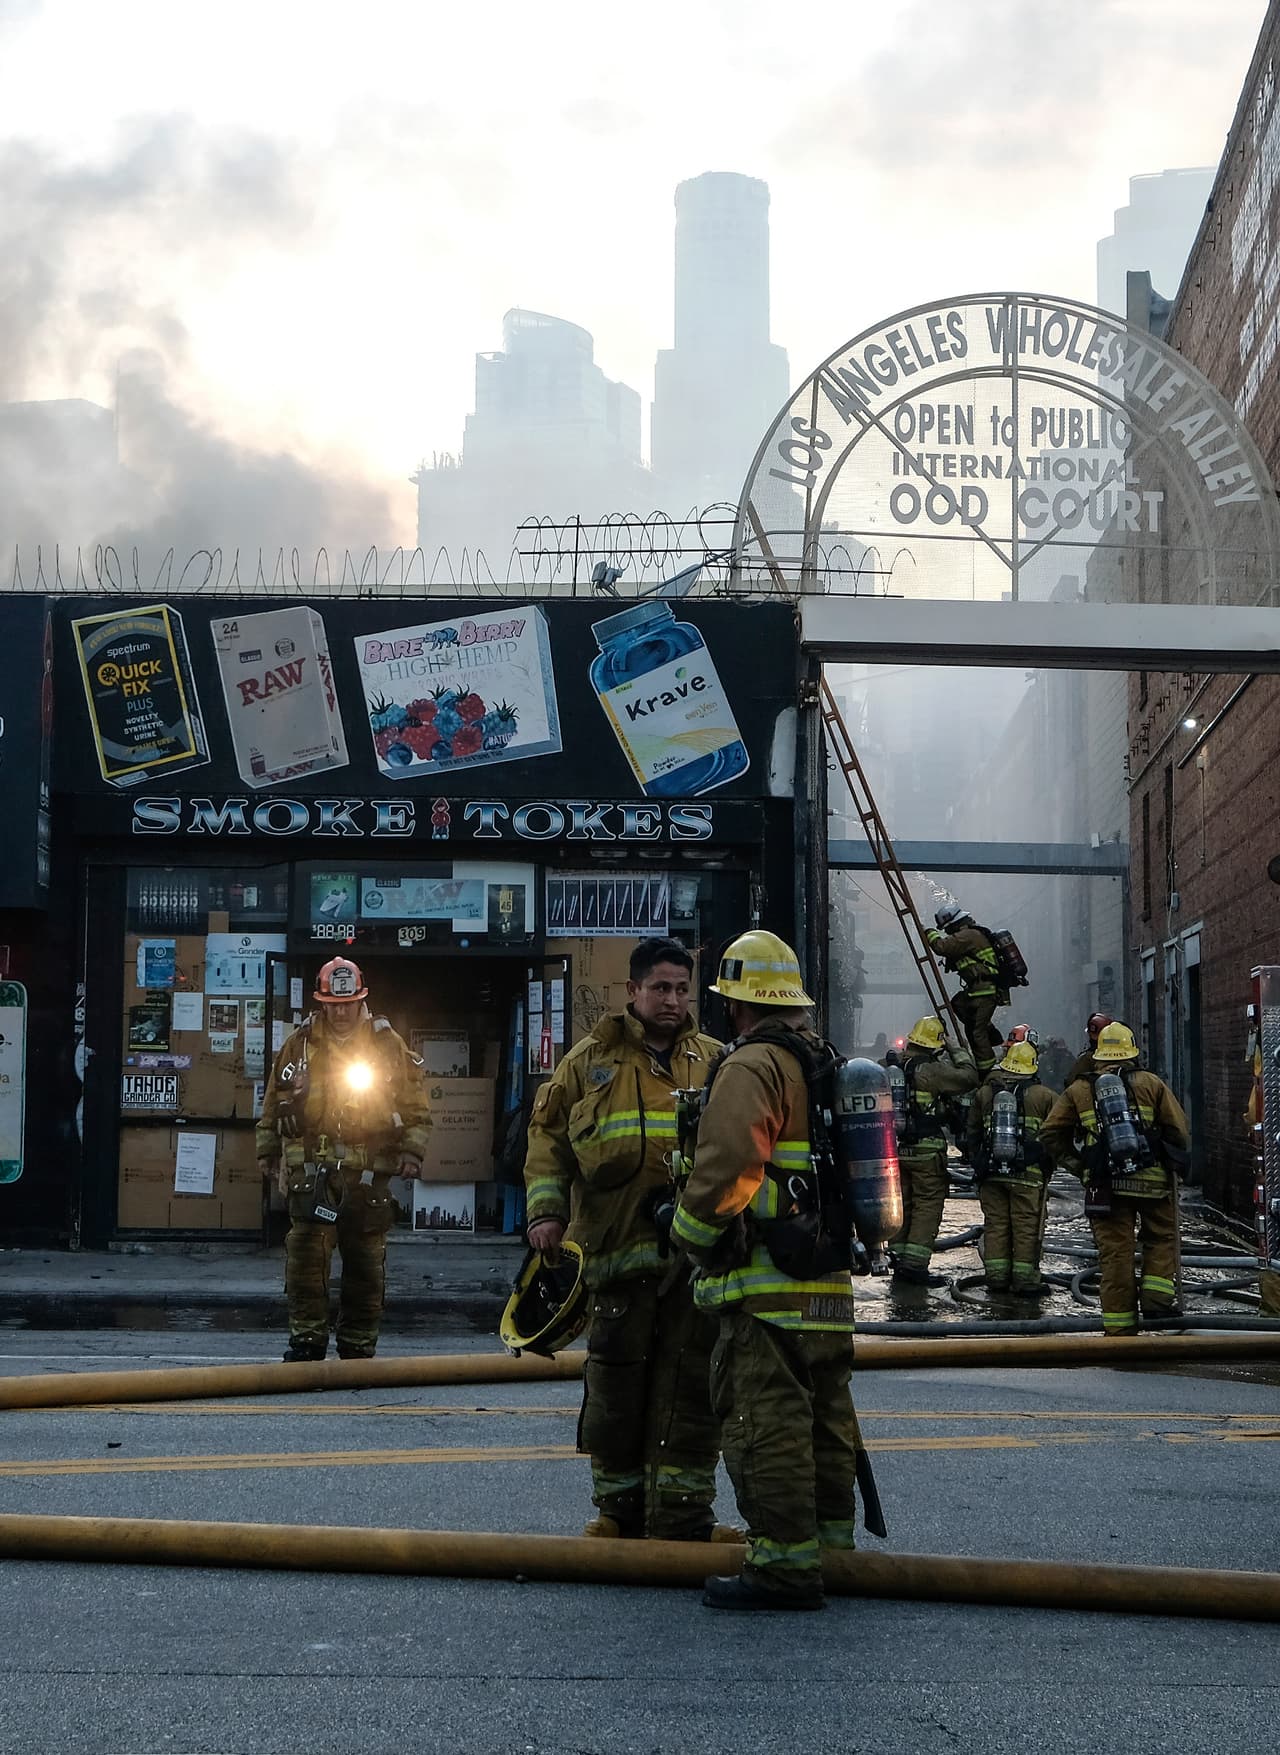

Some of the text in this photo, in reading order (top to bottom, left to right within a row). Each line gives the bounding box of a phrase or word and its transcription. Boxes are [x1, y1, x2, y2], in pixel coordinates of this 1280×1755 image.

[768, 416, 834, 489] LOS
[820, 310, 968, 428] ANGELES
[985, 306, 1186, 412] WHOLESALE
[1170, 396, 1262, 509] ALLEY
[893, 402, 1132, 450] OPEN to PUBLIC
[892, 451, 1141, 485] INTERNATIONAL
[1017, 488, 1165, 534] COURT
[222, 621, 239, 634] 24
[106, 642, 151, 659] spectrum
[363, 619, 526, 665] BARE BERRY
[386, 641, 518, 681] HIGH HEMP
[97, 660, 163, 688] QUICK
[236, 657, 306, 706] RAW
[122, 680, 152, 698] FIX
[127, 697, 154, 713] PLUS
[625, 676, 707, 721] Krave
[125, 711, 160, 726] NOVELTY
[123, 720, 165, 736] SYNTHETIC
[134, 731, 158, 742] URINE
[269, 760, 315, 782] RAW
[131, 796, 714, 842] SMOKE TOKES
[399, 927, 426, 940] 309
[212, 1039, 232, 1047] EAGLE
[124, 1076, 175, 1093] TAHOE
[1101, 1086, 1119, 1097] LFD
[124, 1092, 175, 1103] GRINDER CO
[842, 1095, 876, 1113] LFD
